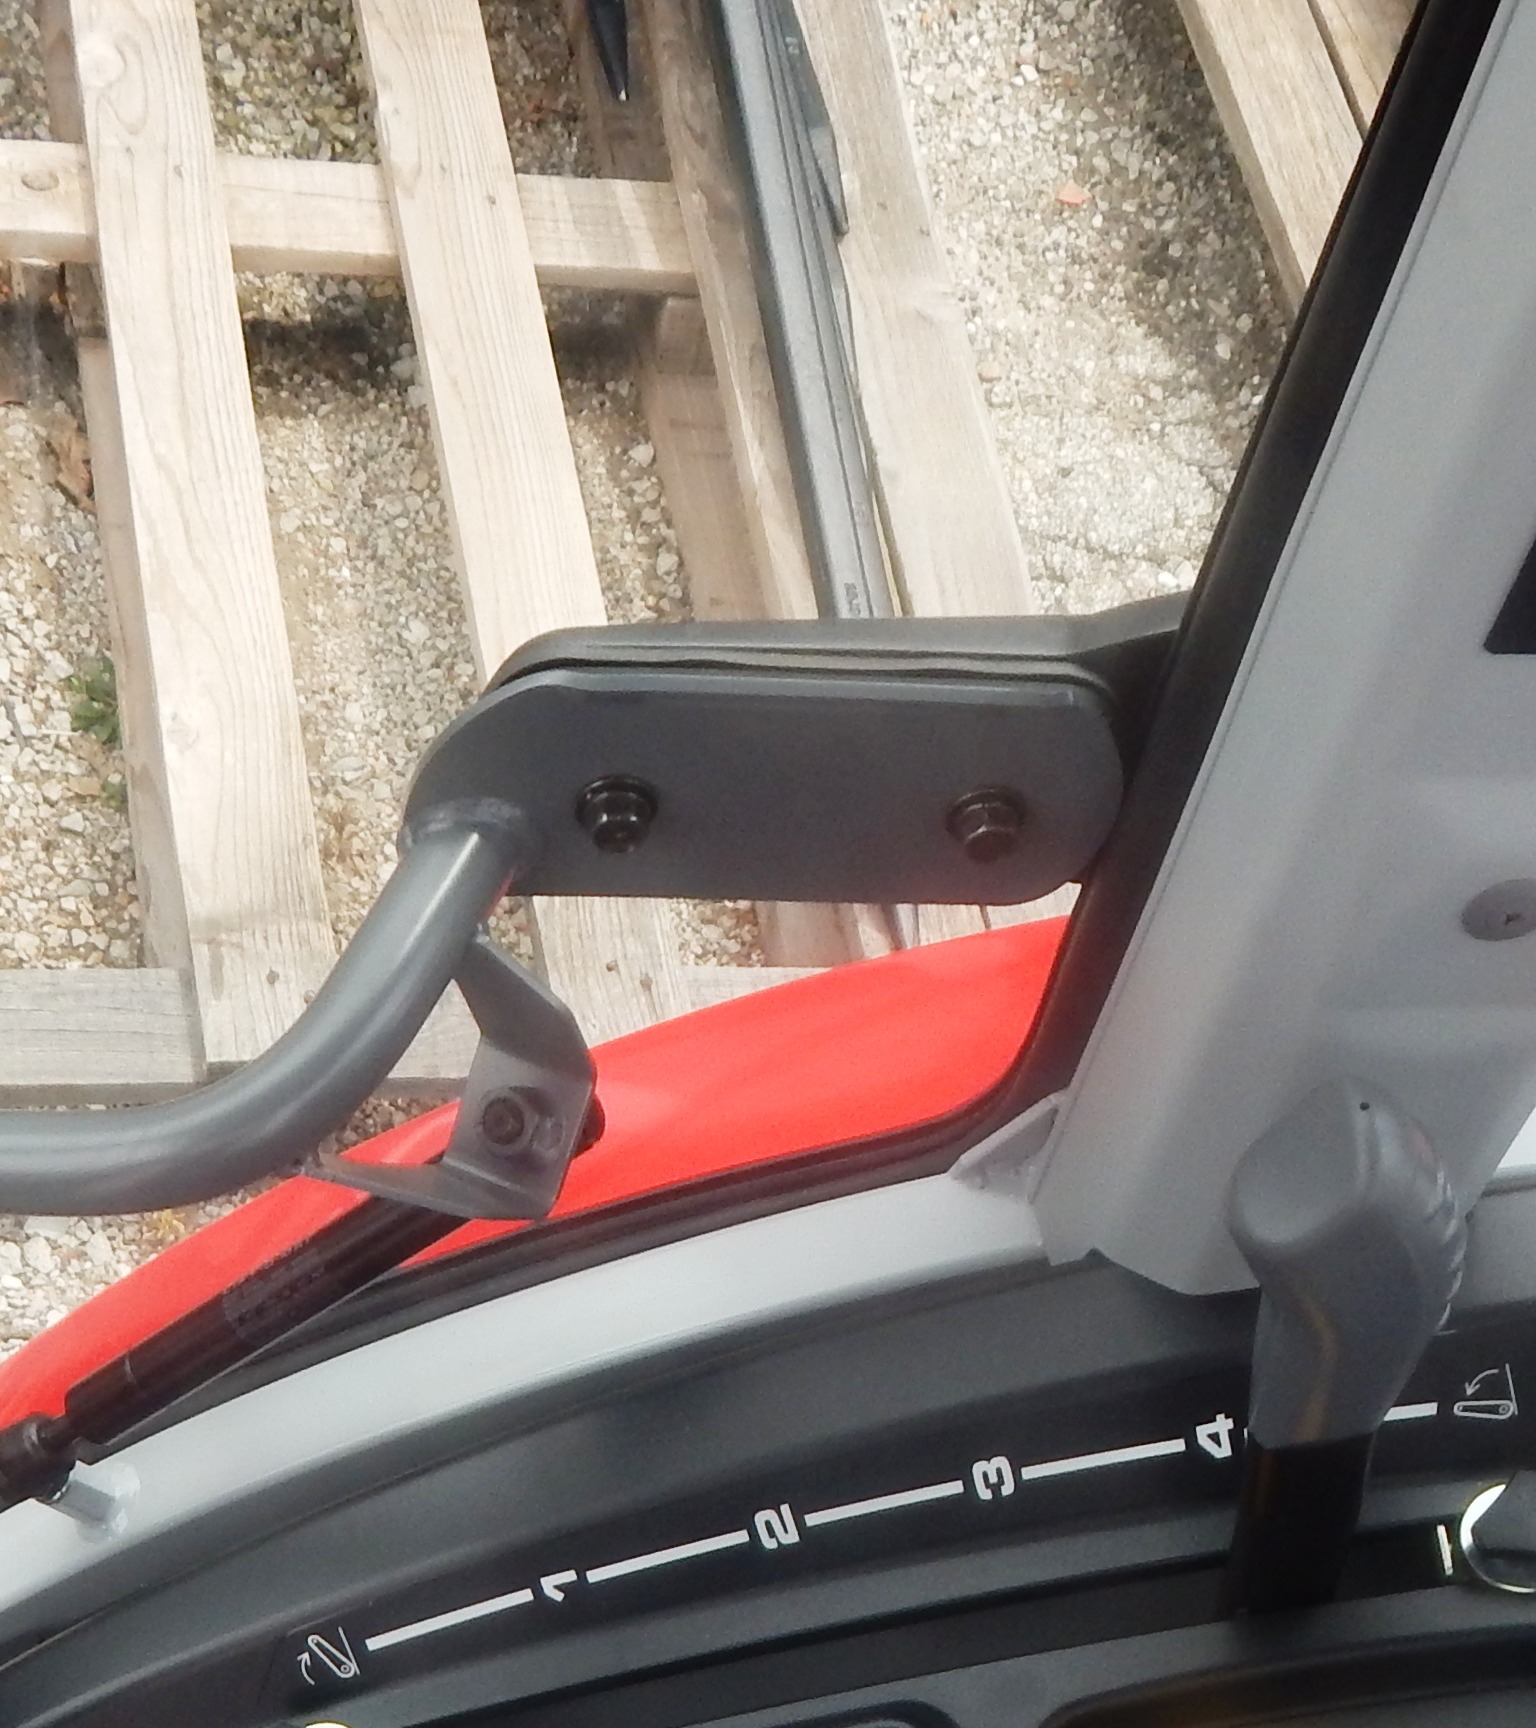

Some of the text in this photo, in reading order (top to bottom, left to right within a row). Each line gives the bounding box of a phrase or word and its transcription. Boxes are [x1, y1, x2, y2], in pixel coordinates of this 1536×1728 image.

[539, 1413, 1234, 1602] 1 2 3 4
